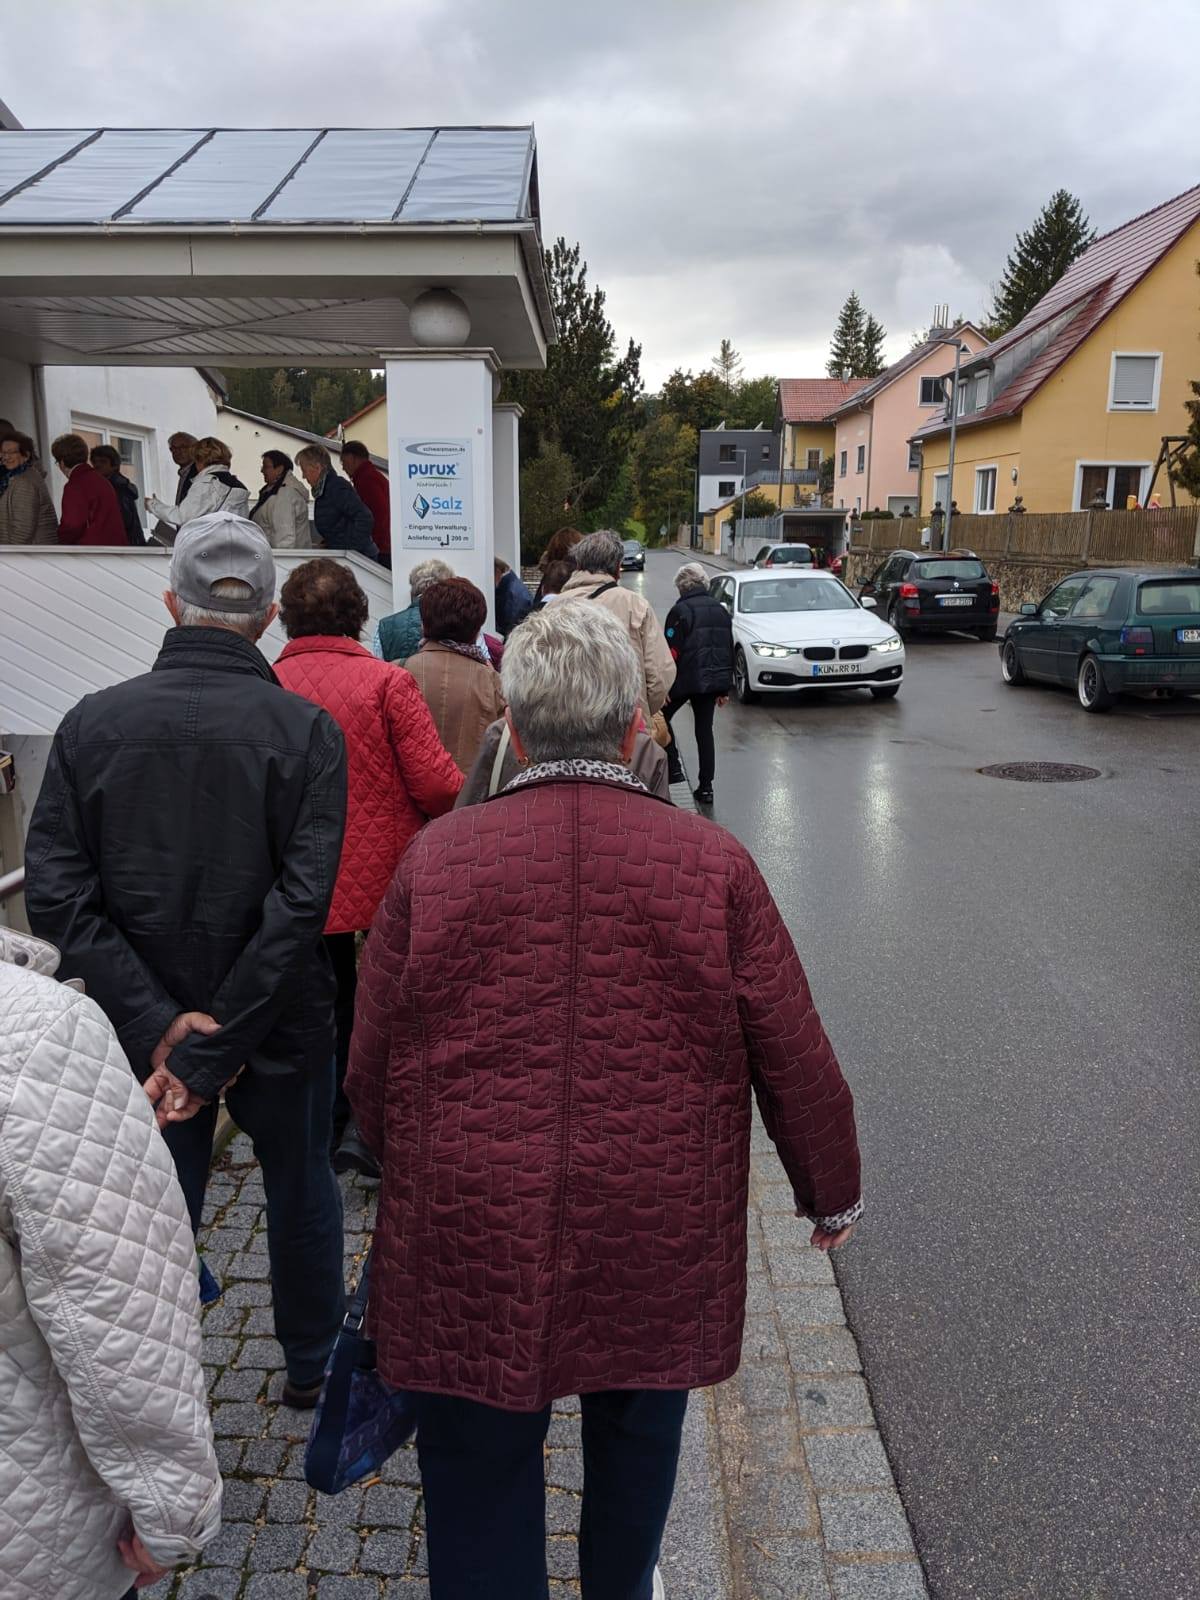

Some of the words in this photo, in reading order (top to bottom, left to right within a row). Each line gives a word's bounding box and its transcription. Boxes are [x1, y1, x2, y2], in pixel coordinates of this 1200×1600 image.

[431, 496, 463, 510] Salz
[408, 524, 434, 532] Eingang
[434, 524, 467, 532] Verwaltung
[407, 534, 442, 542] Anlieferung
[1184, 630, 1190, 640] R
[839, 664, 850, 673] RR
[850, 664, 860, 673] 91
